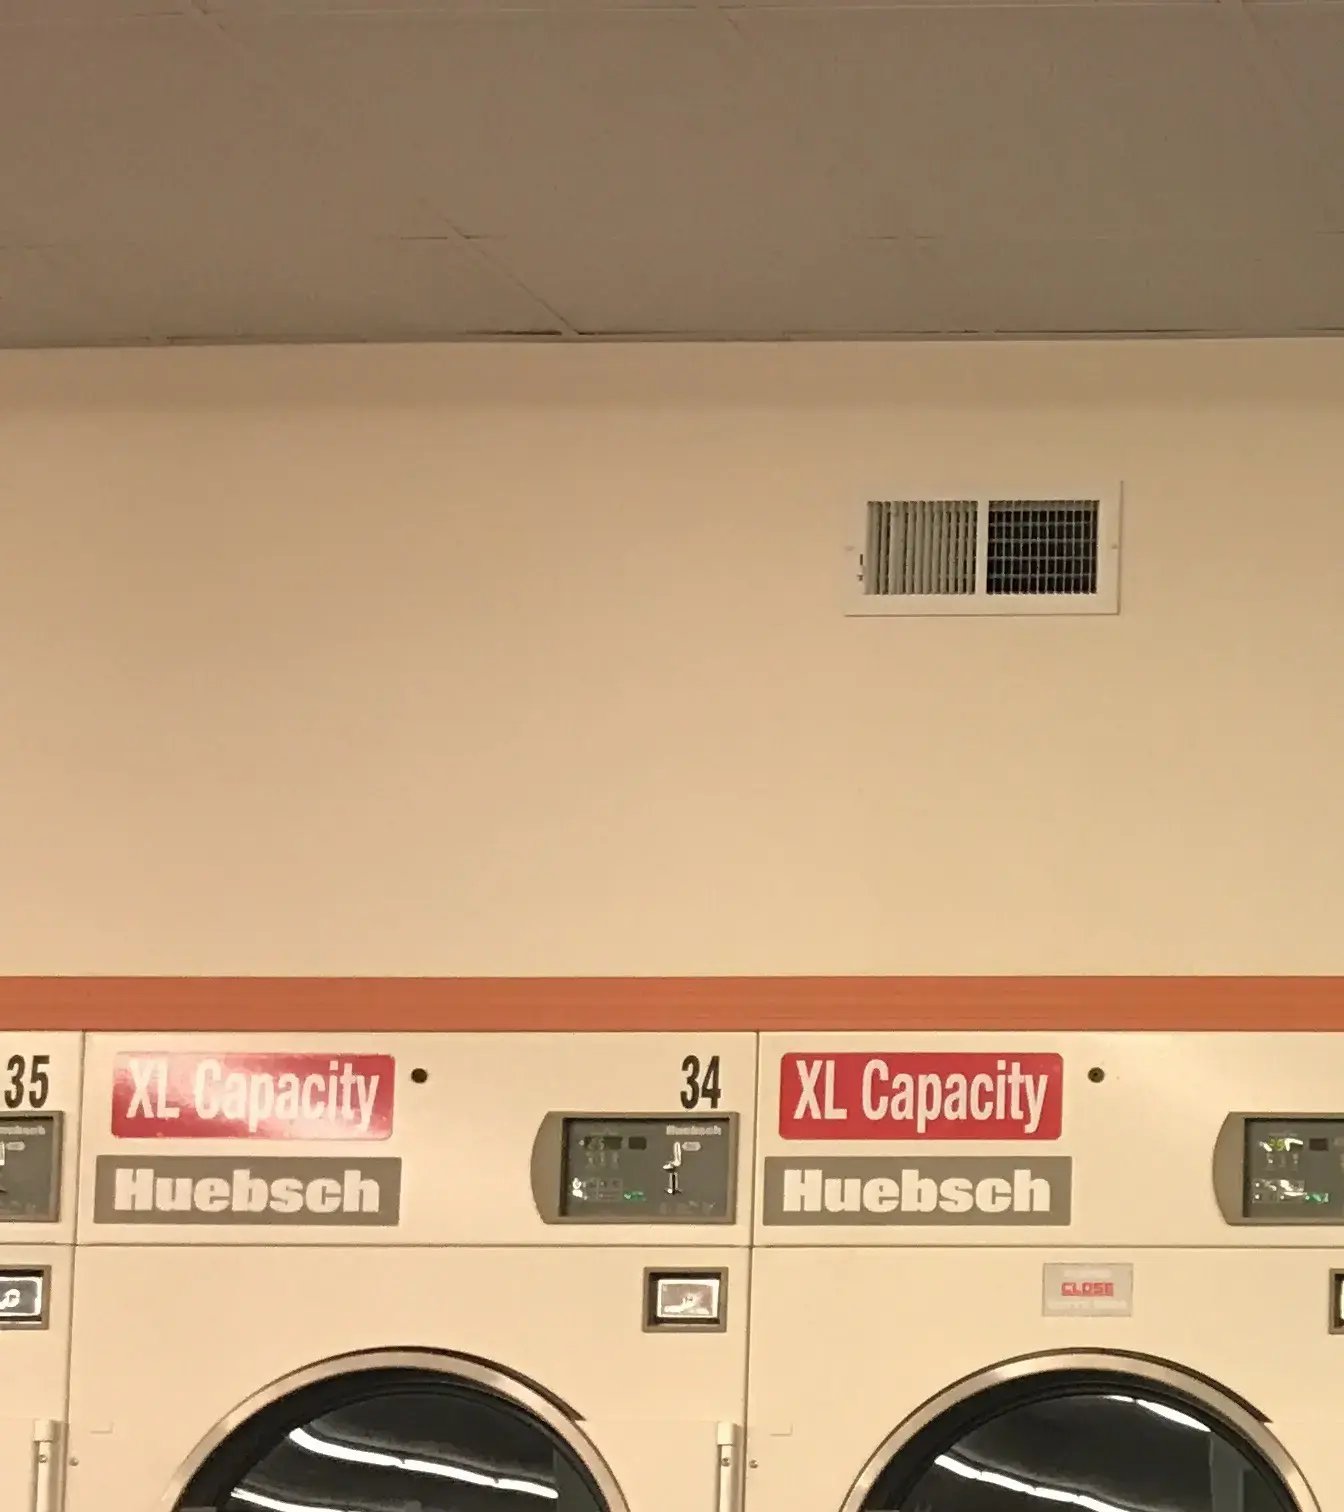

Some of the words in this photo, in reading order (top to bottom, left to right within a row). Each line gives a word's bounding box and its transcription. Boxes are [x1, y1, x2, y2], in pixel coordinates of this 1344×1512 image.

[4, 1054, 50, 1109] 35
[126, 1058, 180, 1119] XL
[193, 1058, 380, 1133] Capacity
[680, 1055, 721, 1110] 34
[793, 1059, 848, 1120] XL
[861, 1058, 1049, 1134] Capacity
[115, 1168, 380, 1213] Huebsch
[782, 1168, 1051, 1213] Huebsch
